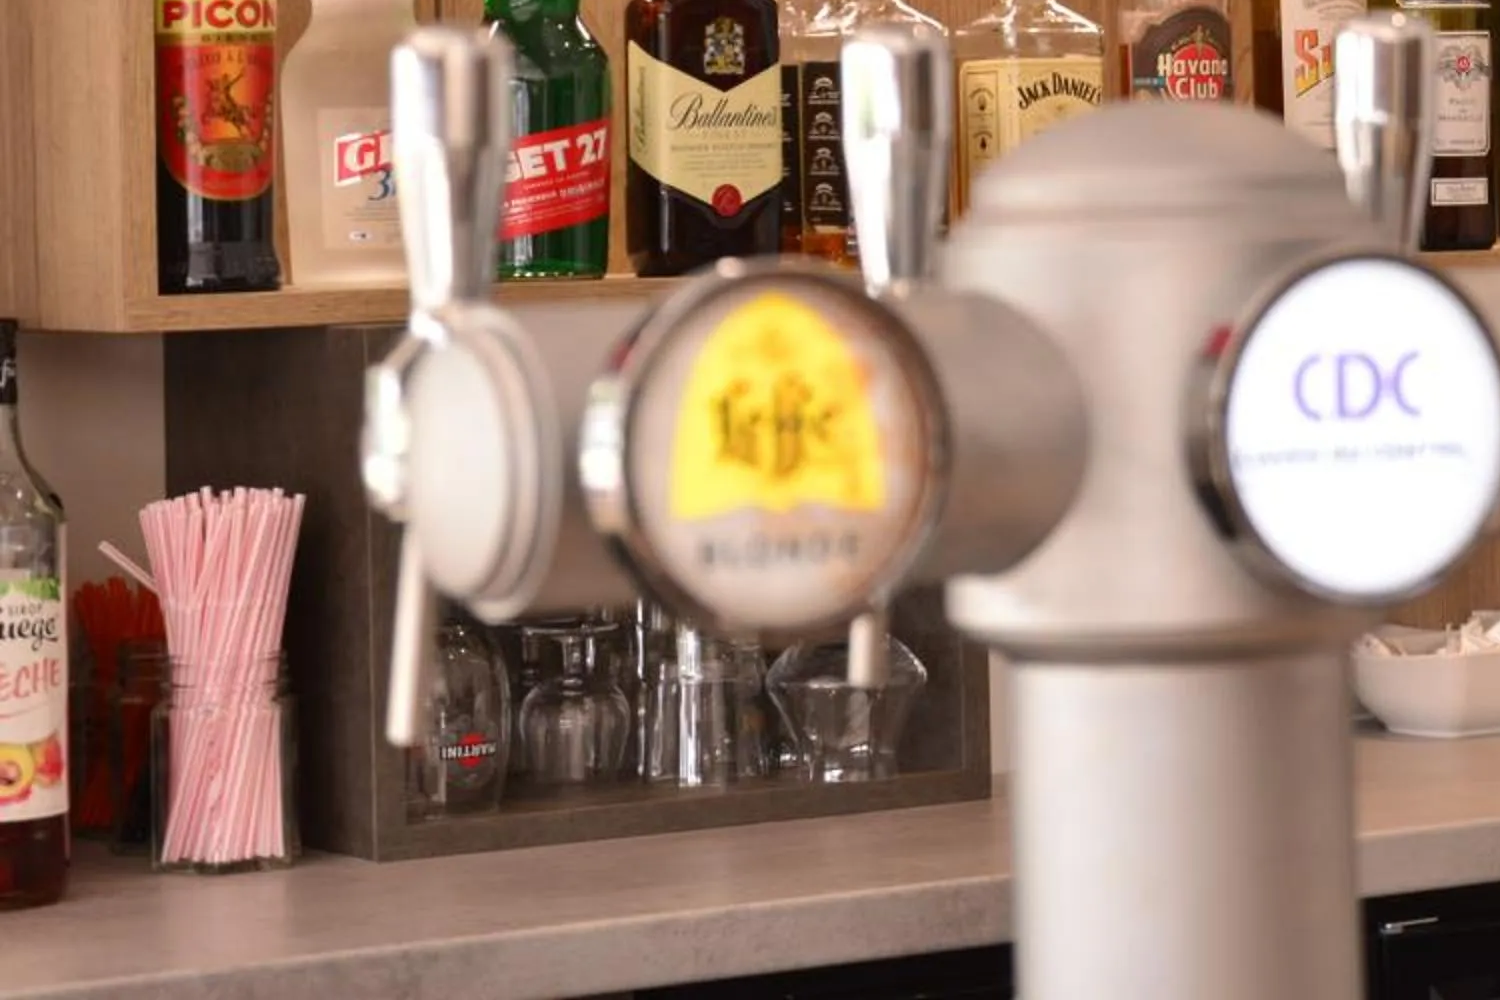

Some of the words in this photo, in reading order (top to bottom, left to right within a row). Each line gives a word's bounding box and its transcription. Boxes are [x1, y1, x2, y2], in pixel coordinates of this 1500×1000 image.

[1157, 52, 1229, 77] Havana
[1017, 79, 1051, 110] JACK
[1175, 76, 1220, 100] Club
[575, 127, 607, 166] 27
